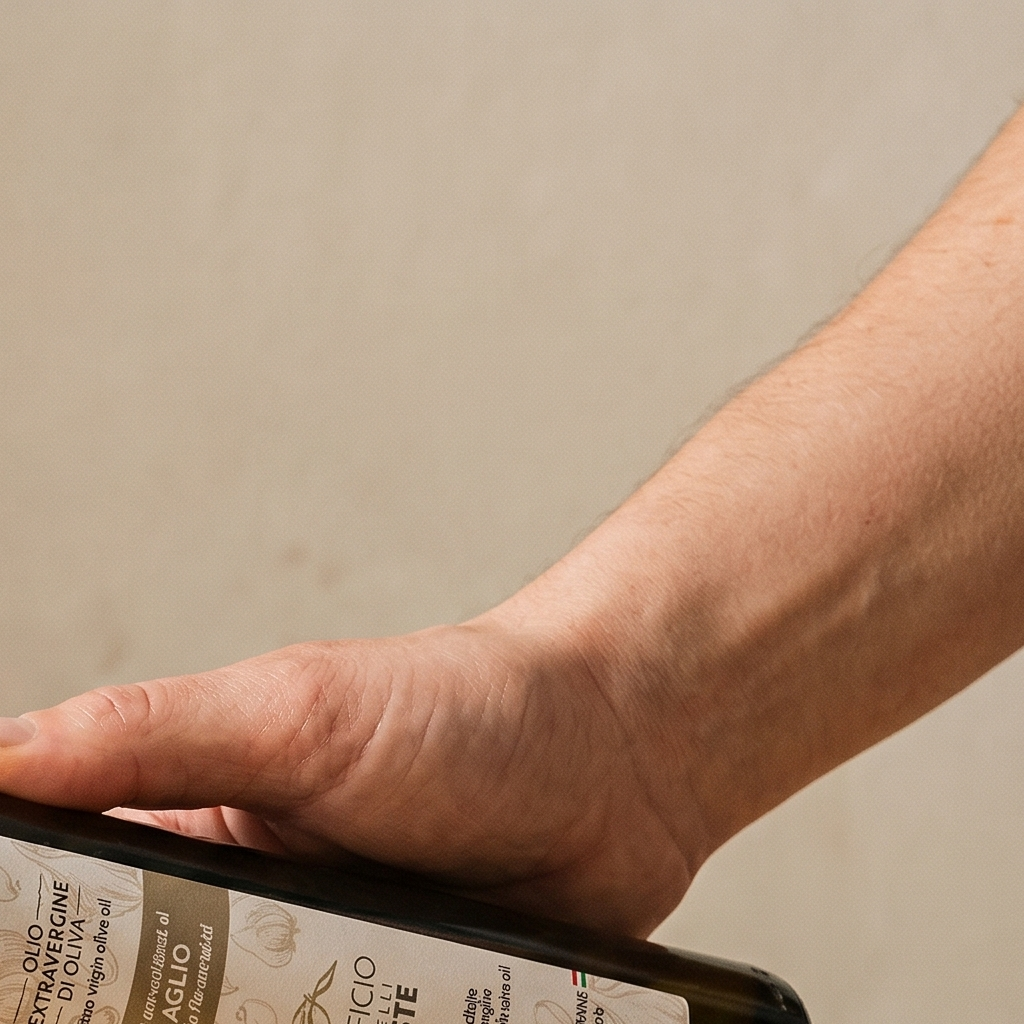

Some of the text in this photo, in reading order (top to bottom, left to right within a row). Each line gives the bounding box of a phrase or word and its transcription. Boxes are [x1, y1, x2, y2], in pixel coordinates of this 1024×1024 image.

[22, 924, 44, 973] OLIO
[57, 918, 86, 1002] DI OLIVA
[162, 943, 191, 1024] AGLIO
